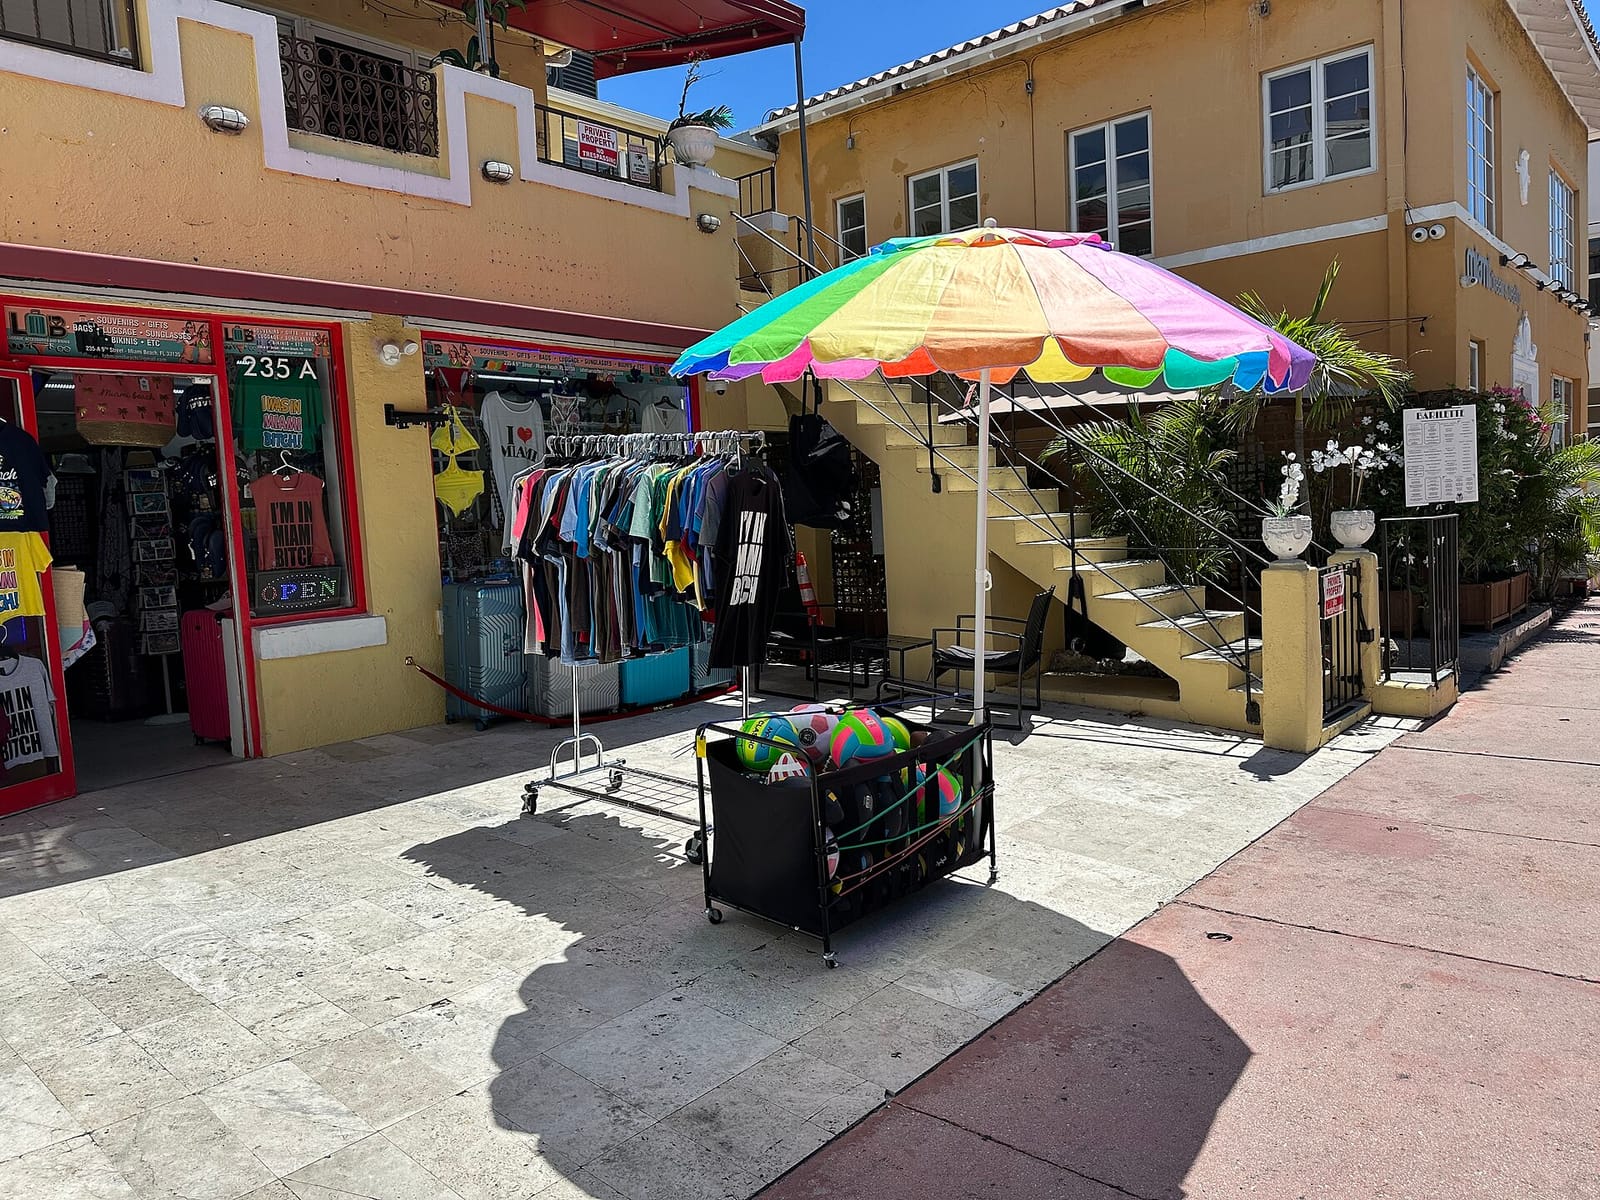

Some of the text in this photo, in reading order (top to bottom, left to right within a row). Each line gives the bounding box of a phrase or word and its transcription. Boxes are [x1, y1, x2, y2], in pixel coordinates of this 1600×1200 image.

[581, 133, 615, 149] PROPERTY
[584, 125, 611, 140] PRIVATE
[582, 150, 616, 165] TRESPASSING
[596, 147, 605, 155] NO
[72, 323, 192, 340] BAGS LUGGAGE SUNGLASSES
[96, 316, 169, 329] SOUVENIRS GIFTS
[111, 336, 161, 347] BIKINIS ETC
[242, 355, 317, 380] 235 A
[266, 395, 289, 414] WAS
[289, 398, 302, 415] IN
[263, 413, 303, 432] MIAMI
[263, 431, 303, 449] BITCH!
[506, 425, 514, 445] I
[270, 500, 313, 524] I'M IN
[261, 580, 337, 601] OPEN
[15, 685, 33, 710] IN
